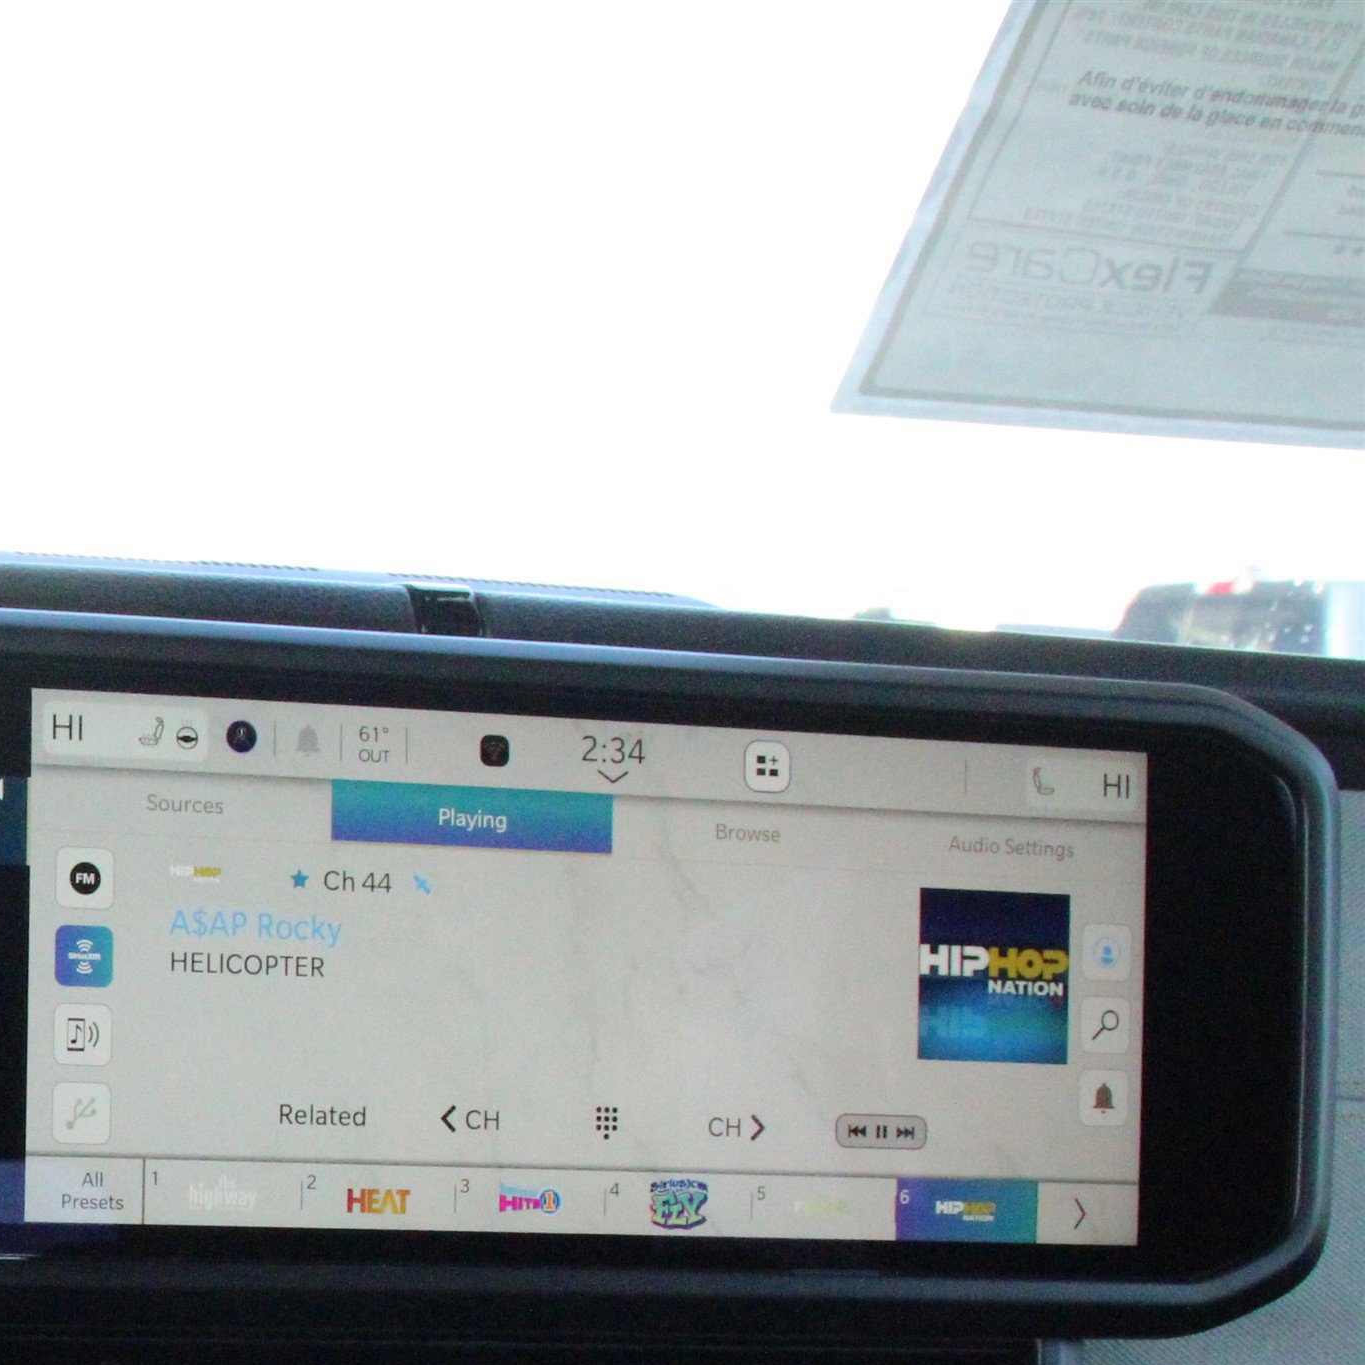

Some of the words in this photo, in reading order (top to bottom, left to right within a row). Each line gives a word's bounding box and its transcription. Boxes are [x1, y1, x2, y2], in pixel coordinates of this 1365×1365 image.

[51, 714, 84, 741] HI
[358, 748, 390, 764] OUT
[581, 735, 645, 765] 2:34
[1103, 774, 1130, 798] HI
[146, 793, 224, 815] Sources
[438, 807, 508, 833] Playing
[715, 824, 781, 843] Browse
[949, 836, 999, 855] Audio
[1005, 838, 1074, 860] Settings
[75, 872, 95, 885] FM
[324, 870, 354, 892] Ch
[363, 873, 391, 893] 44
[170, 909, 247, 938] A$AP
[258, 913, 342, 948] Rocky
[170, 952, 324, 978] HELICOPTER
[988, 979, 1064, 996] NATION
[279, 1105, 367, 1128] Related
[465, 1110, 500, 1131] CH
[708, 1117, 741, 1138] CH
[82, 1172, 103, 1187] All
[306, 1175, 317, 1190] 2
[460, 1179, 470, 1193] 3
[609, 1183, 620, 1197] 4
[61, 1194, 124, 1210] Presets
[347, 1188, 411, 1214] HEAT
[757, 1186, 766, 1201] 5
[899, 1189, 910, 1205] 6
